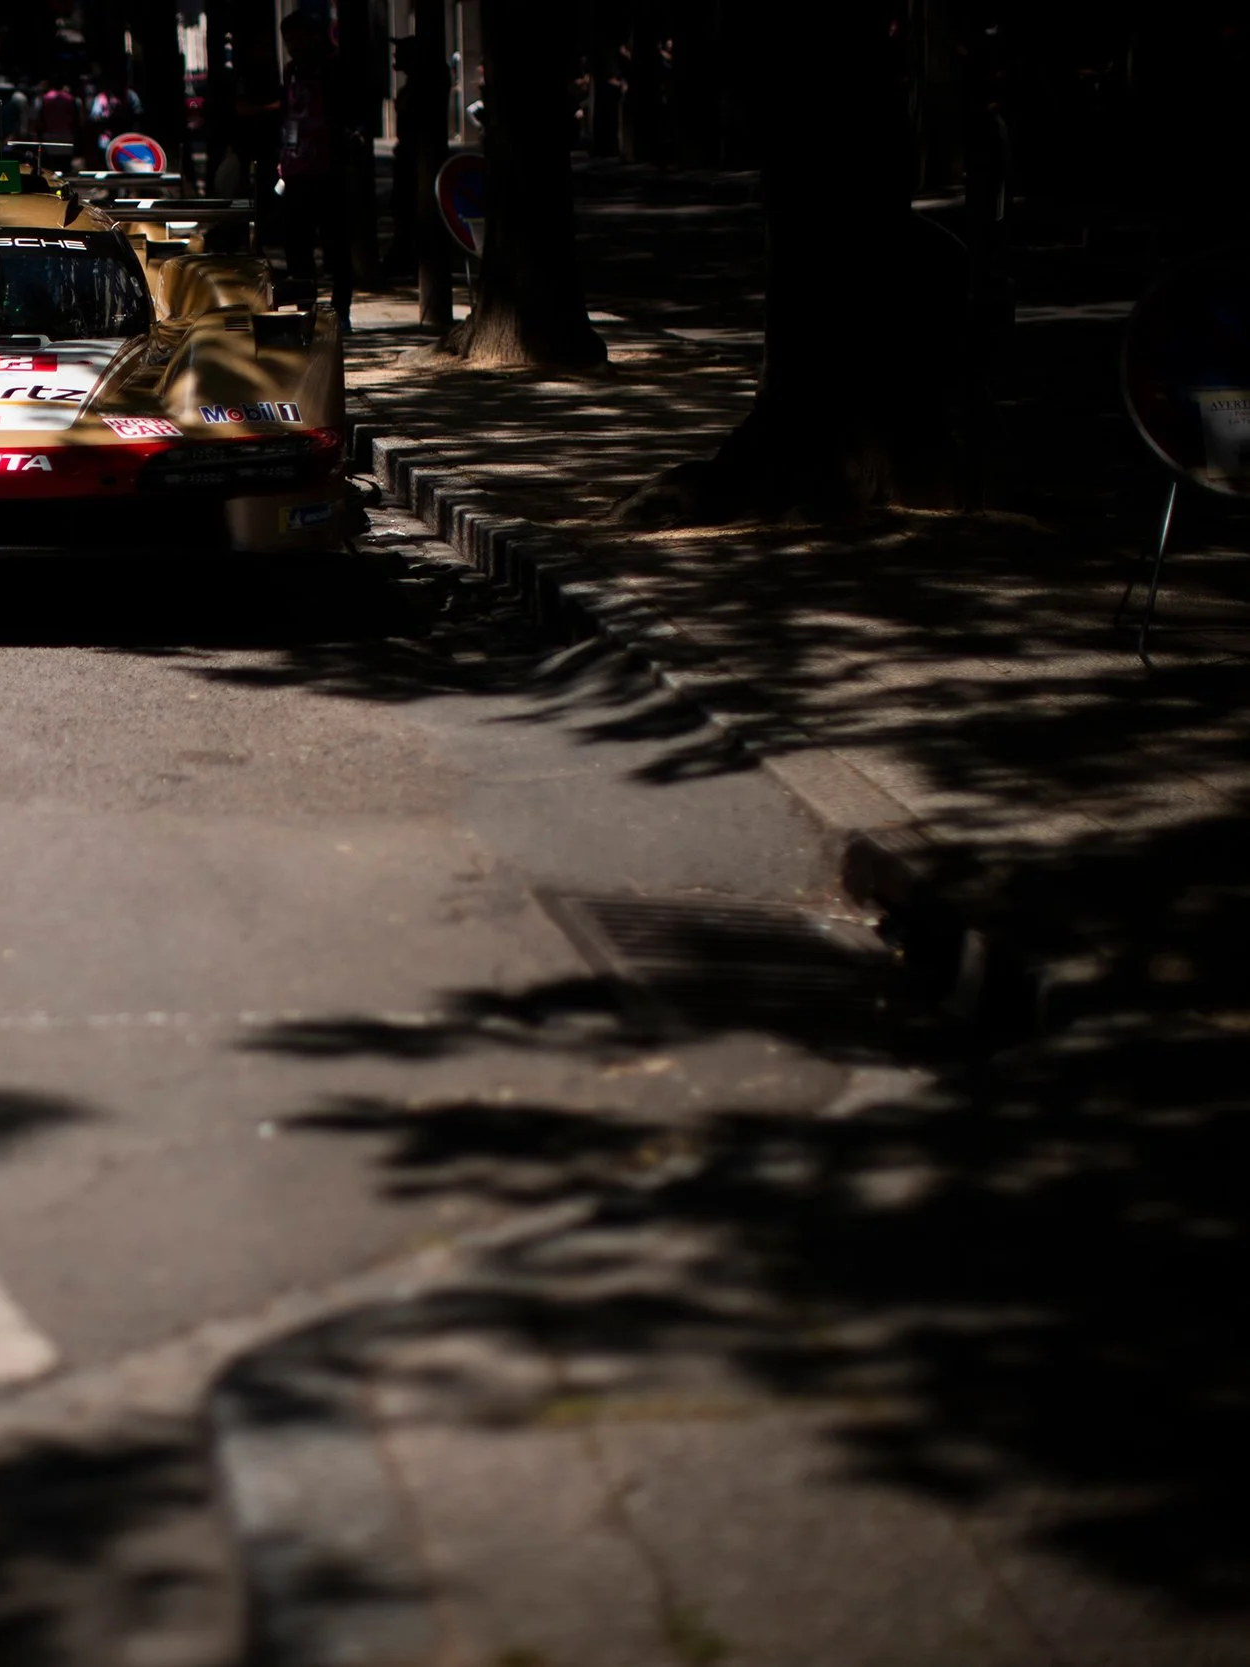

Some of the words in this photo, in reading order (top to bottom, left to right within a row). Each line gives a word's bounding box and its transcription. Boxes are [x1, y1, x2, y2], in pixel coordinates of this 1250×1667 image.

[200, 402, 275, 424] Mobil
[107, 418, 166, 426] HYPER
[116, 425, 180, 436] CAR
